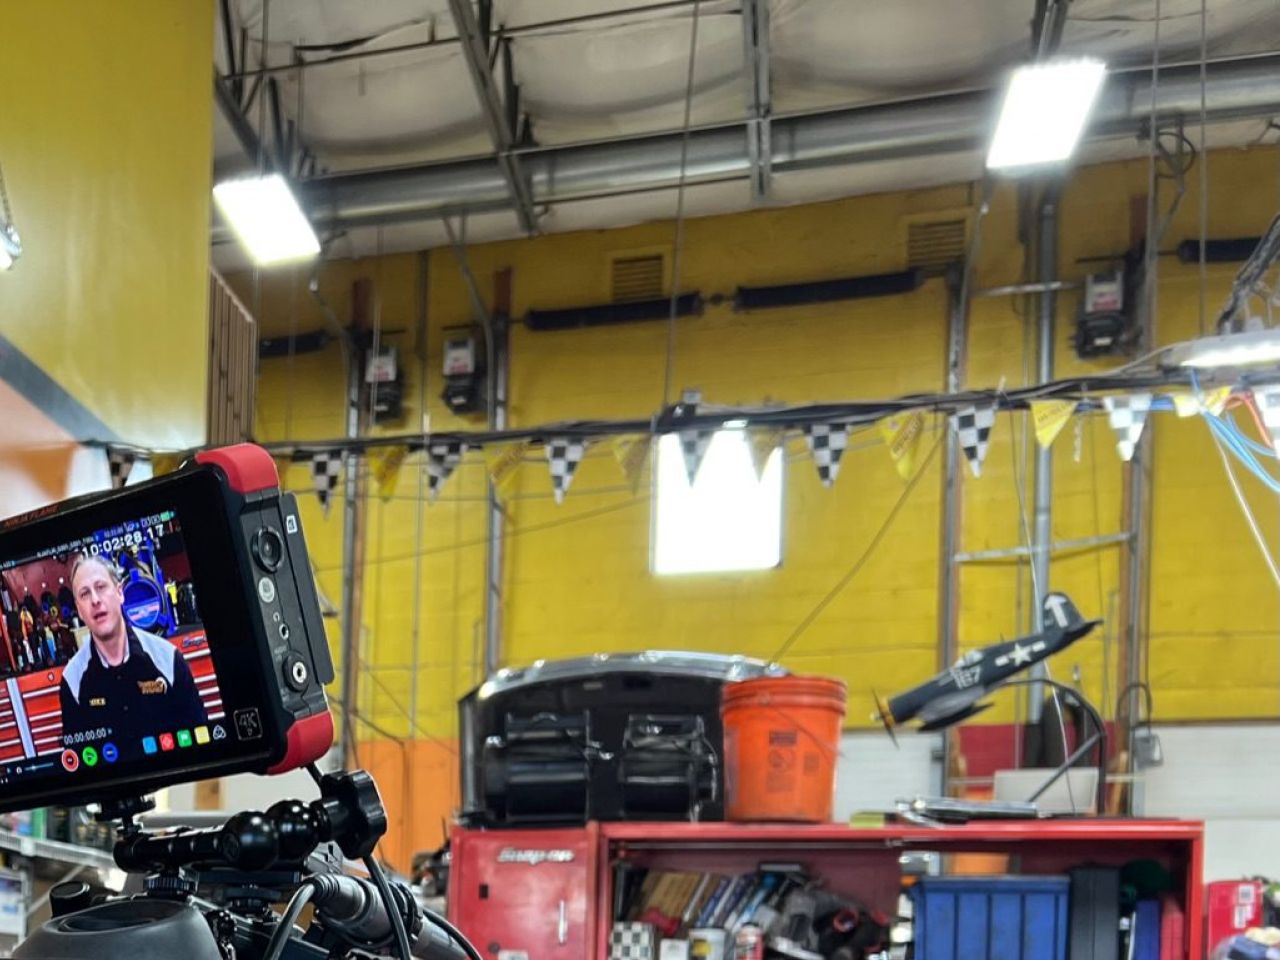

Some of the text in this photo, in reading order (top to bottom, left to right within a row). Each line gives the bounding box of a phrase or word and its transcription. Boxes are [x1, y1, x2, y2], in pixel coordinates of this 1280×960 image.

[82, 524, 165, 558] 10:02:28.17
[239, 712, 257, 728] 4K
[63, 727, 107, 745] 00:00:00.00
